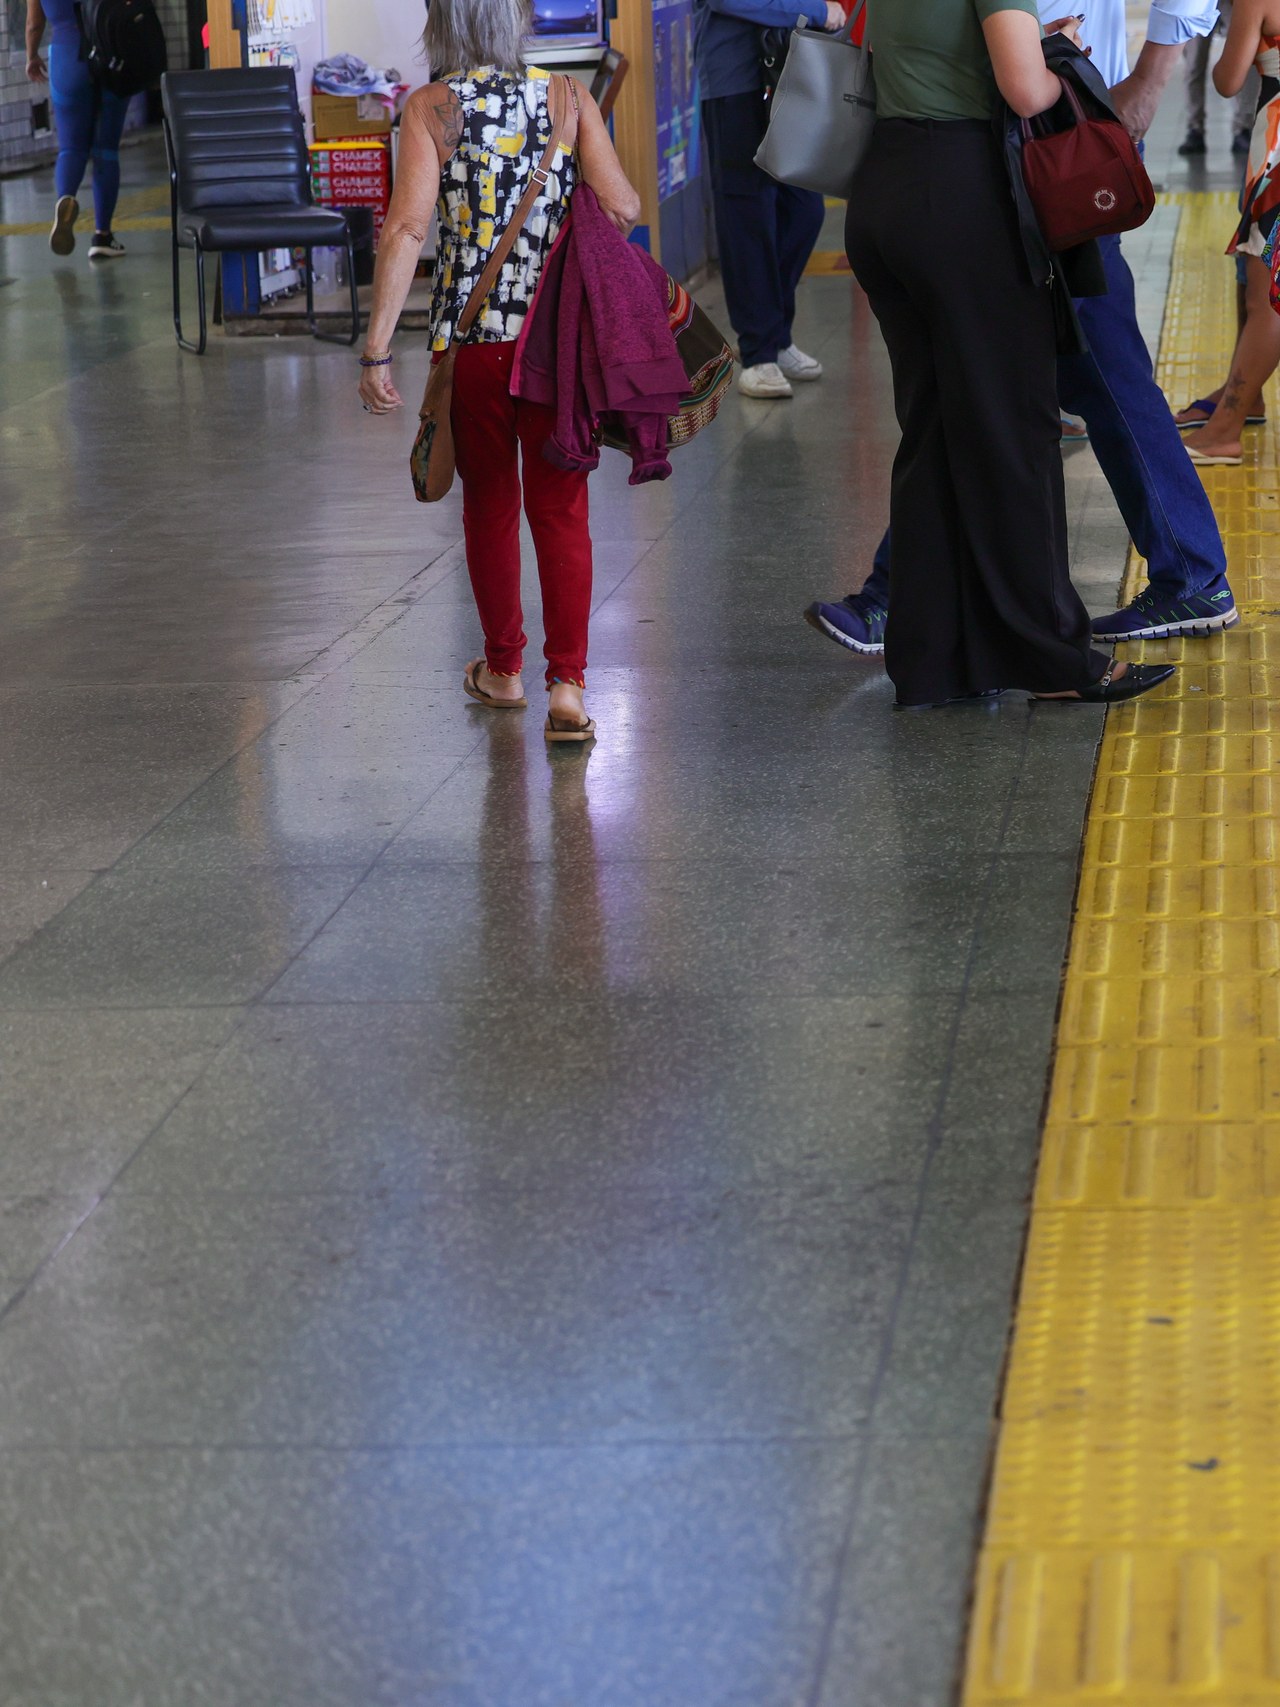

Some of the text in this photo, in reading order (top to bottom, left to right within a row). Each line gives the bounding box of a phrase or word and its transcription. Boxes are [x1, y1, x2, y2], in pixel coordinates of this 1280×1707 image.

[332, 151, 382, 161] CHAMEX
[333, 161, 382, 172] CHAMEX
[332, 176, 382, 187] CHAMEX
[334, 187, 384, 198] CHAMEX
